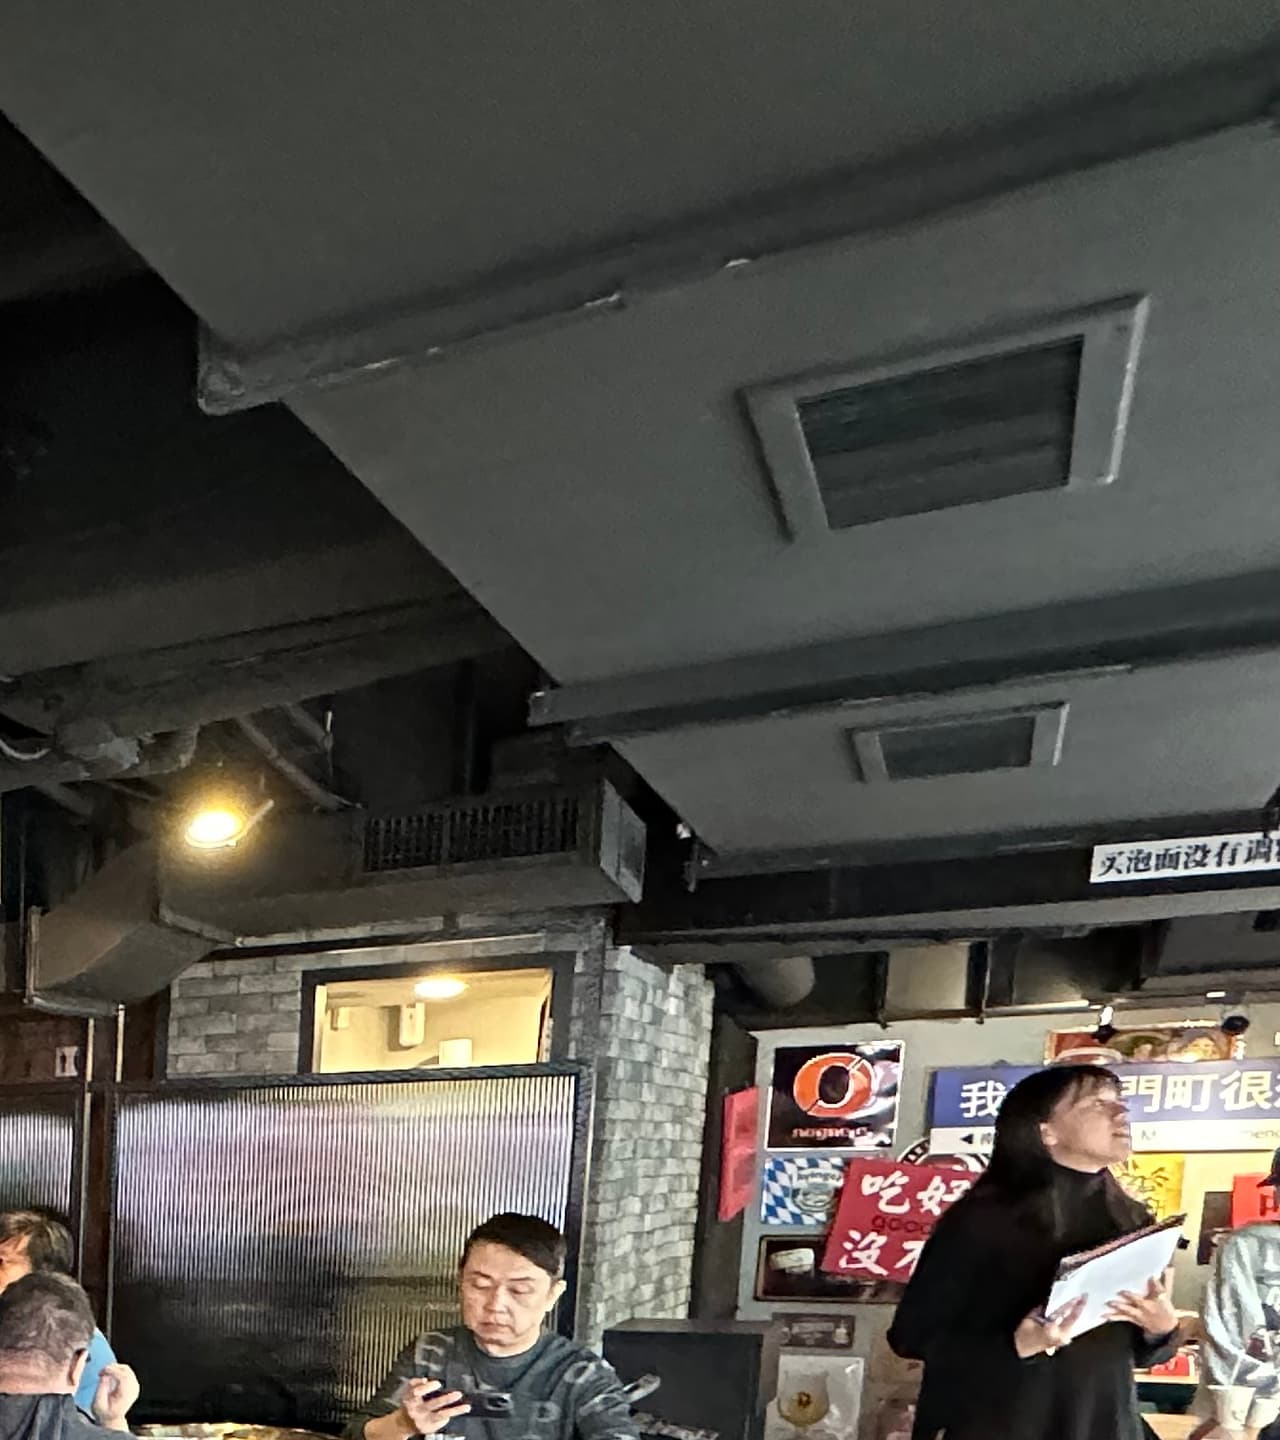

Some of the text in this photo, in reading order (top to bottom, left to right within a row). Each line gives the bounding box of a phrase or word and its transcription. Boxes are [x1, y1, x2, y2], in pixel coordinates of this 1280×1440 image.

[959, 1070, 1280, 1119] 我 門町很
